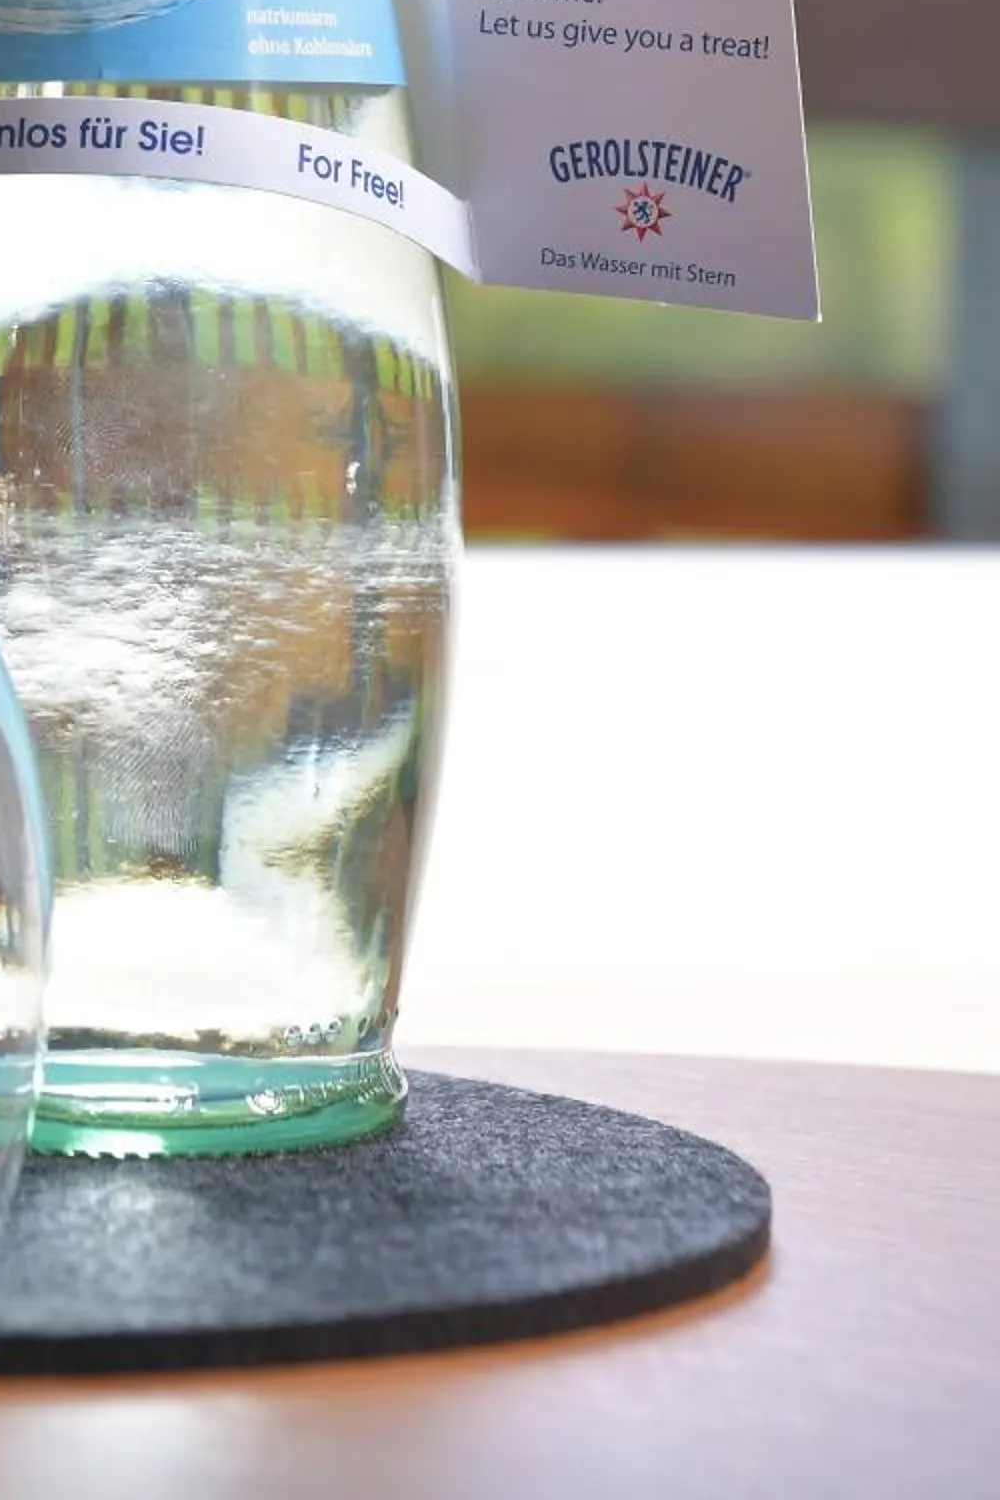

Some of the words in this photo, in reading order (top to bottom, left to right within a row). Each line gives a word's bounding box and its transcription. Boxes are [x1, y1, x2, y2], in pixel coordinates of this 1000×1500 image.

[479, 10, 520, 37] Let
[527, 20, 555, 39] us
[563, 21, 617, 48] give
[625, 28, 673, 52] you
[680, 35, 694, 52] a
[703, 33, 769, 60] treat!
[80, 118, 129, 149] für
[138, 120, 205, 155] Sie!
[298, 144, 342, 183] For
[350, 157, 404, 209] Free!
[549, 139, 744, 203] GEROLSTEINER
[540, 248, 576, 269] Das
[580, 252, 646, 276] Wasser
[651, 261, 682, 281] mit
[687, 264, 737, 287] Stern
